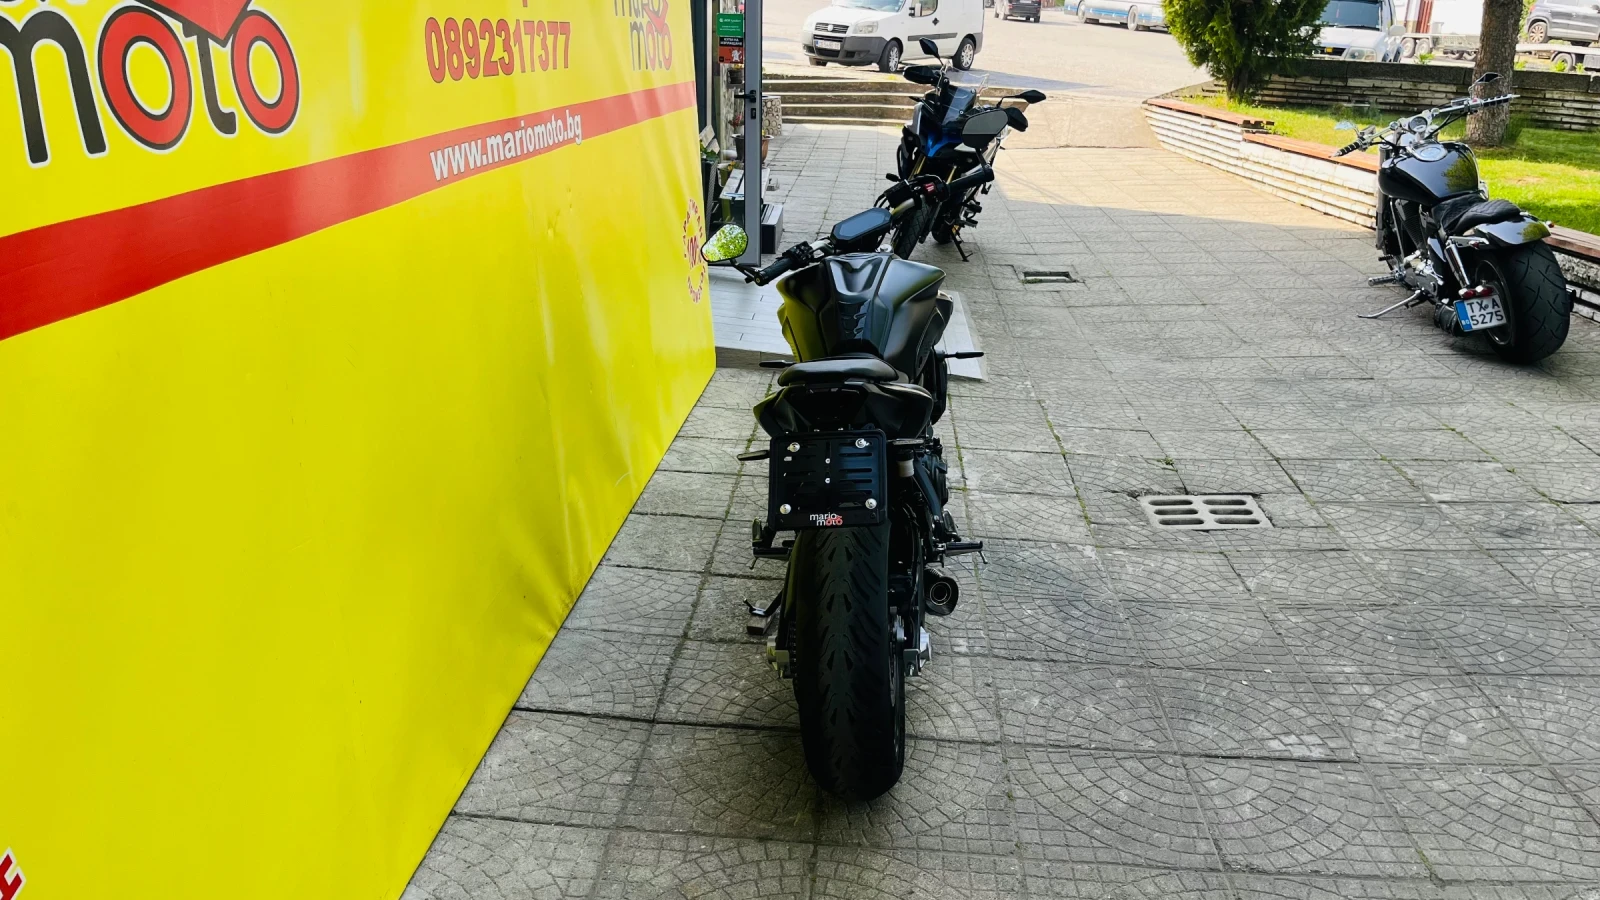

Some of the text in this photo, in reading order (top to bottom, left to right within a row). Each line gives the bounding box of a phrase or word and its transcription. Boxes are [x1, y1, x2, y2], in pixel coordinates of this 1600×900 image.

[425, 17, 571, 83] 0892317377
[629, 21, 673, 72] moto
[429, 109, 582, 181] www.mariomoto.bg
[1466, 298, 1501, 313] TX A
[1470, 310, 1504, 326] 5275
[809, 512, 837, 521] mario
[816, 517, 843, 526] moto
